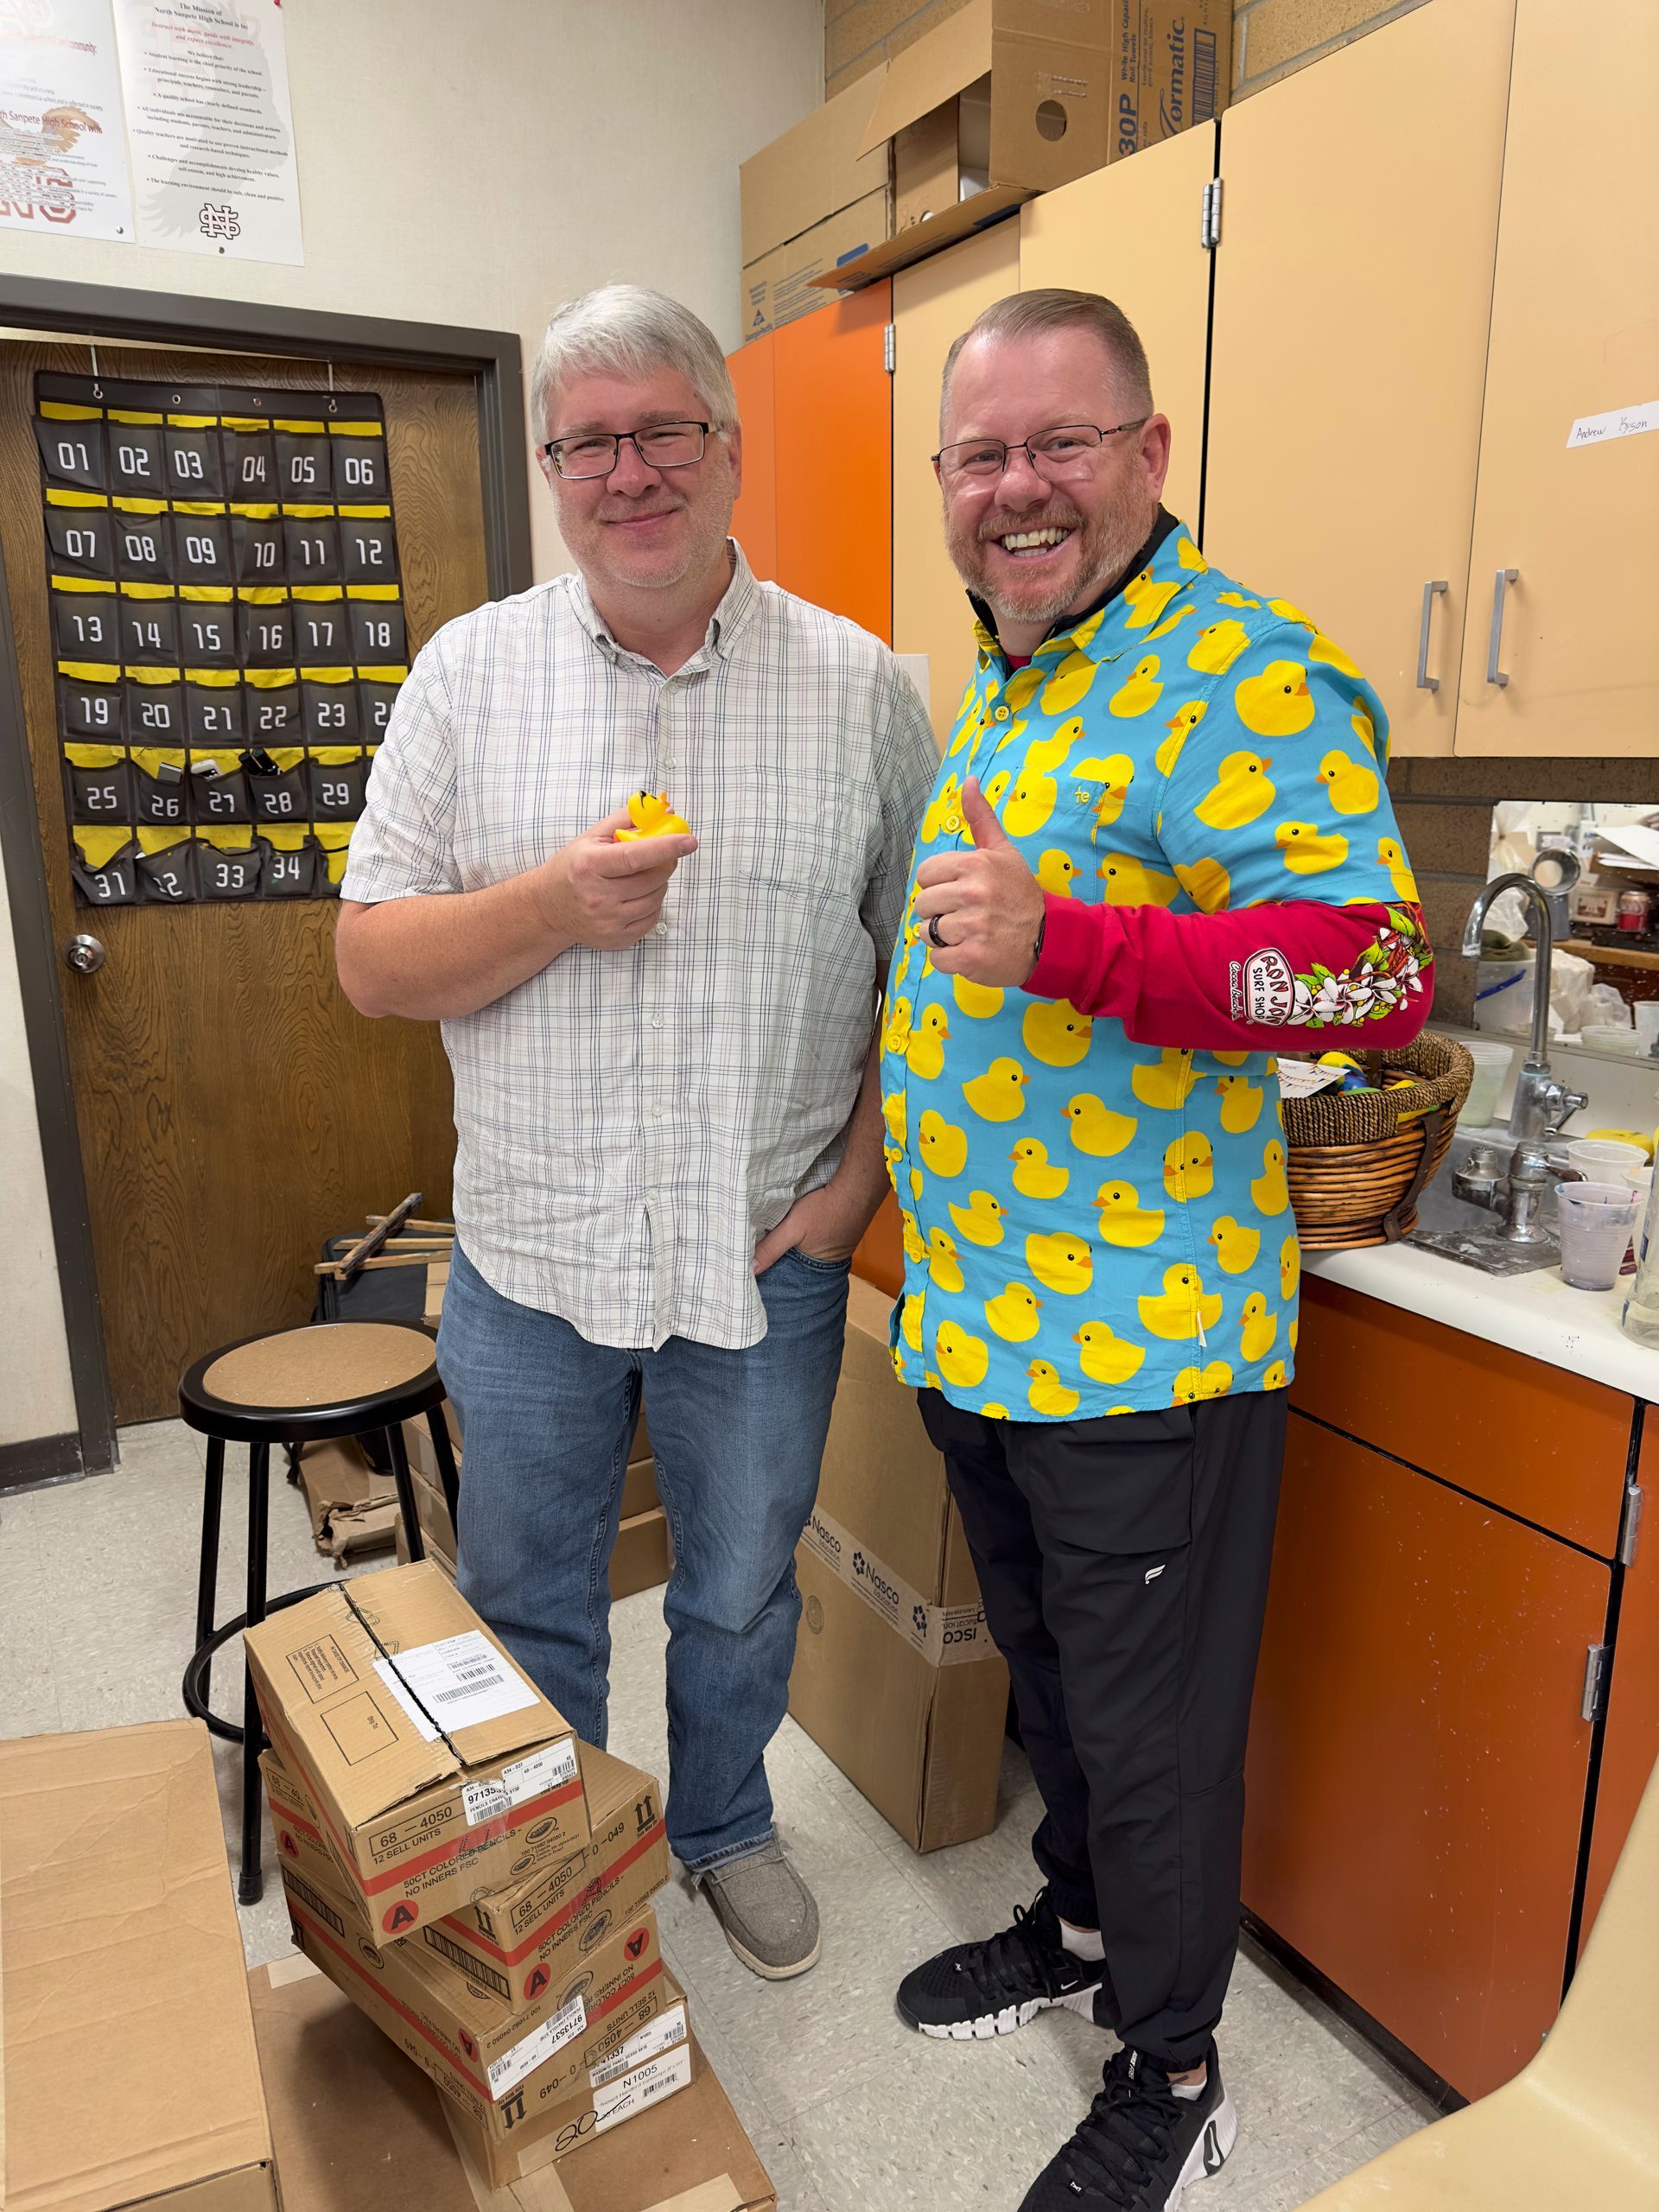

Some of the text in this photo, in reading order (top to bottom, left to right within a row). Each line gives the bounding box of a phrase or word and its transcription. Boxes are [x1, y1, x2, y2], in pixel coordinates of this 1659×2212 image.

[174, 10, 197, 20] Sanpete
[199, 14, 213, 23] High
[214, 17, 233, 26] School
[192, 5, 214, 14] Mission
[152, 22, 173, 30] Instruct
[187, 28, 202, 36] merit,
[232, 35, 255, 46] integrity,
[205, 39, 233, 49] excellence.
[168, 55, 188, 64] learning
[9, 111, 41, 124] Sanpete
[42, 117, 60, 129] High
[61, 119, 86, 131] School
[1576, 416, 1647, 441] Andrew Kyson
[58, 442, 373, 486] 01 02 03 04 05 06
[66, 530, 382, 567] 07 08 09 10 11 12
[73, 615, 391, 651] 13 14 15 16 17 18
[80, 697, 109, 725] 19
[141, 702, 170, 729] 20
[204, 706, 232, 731] 21
[259, 705, 288, 730] 22
[318, 703, 346, 728] 23
[86, 783, 349, 818] 25 26 27 28 29
[94, 871, 126, 899] 31
[215, 863, 245, 889] 33
[272, 855, 301, 880] 34
[1230, 962, 1241, 988] Cocoa
[1253, 967, 1265, 1019] SURF SHOP
[1260, 956, 1289, 1024] RON JON
[812, 1515, 842, 1553] Nasco
[866, 1561, 899, 1605] Nasco
[470, 1800, 488, 1812] PENCILS
[380, 1806, 453, 1847] 68 4050
[373, 1828, 442, 1865] 12 SELL UNITS
[404, 1872, 426, 1888] 50CT
[429, 1849, 475, 1875] COLORED
[405, 1858, 479, 1898] NO INNERS FSC
[519, 1901, 532, 1917] 68
[548, 1867, 572, 1892] 4050
[592, 1844, 599, 1855] 0
[391, 1905, 415, 1931] A
[514, 1889, 565, 1935] 12 SELL UNITS
[538, 1878, 620, 1953] 50CT COLORED PENCILS
[539, 1910, 593, 1962] NO INNERS FSC
[627, 1933, 643, 1957] A
[530, 1970, 547, 1996] A
[594, 1964, 634, 1994] NO INNERS
[617, 1972, 635, 1987] 50CT
[511, 2015, 529, 2030] 71662
[531, 2005, 541, 2015] 100
[607, 1990, 655, 2031] 12 SELL UNITS
[639, 2006, 651, 2020] 68
[494, 2027, 511, 2043] 04050
[551, 2014, 582, 2044] 9713537
[598, 2030, 622, 2053] 4050
[461, 2032, 473, 2056] A
[570, 2065, 576, 2075] 0
[593, 2066, 611, 2077] MASONITE
[613, 2058, 624, 2067] PANEL
[623, 2063, 658, 2088] N1005
[612, 2098, 635, 2115] EACH
[555, 2105, 610, 2152] 20
